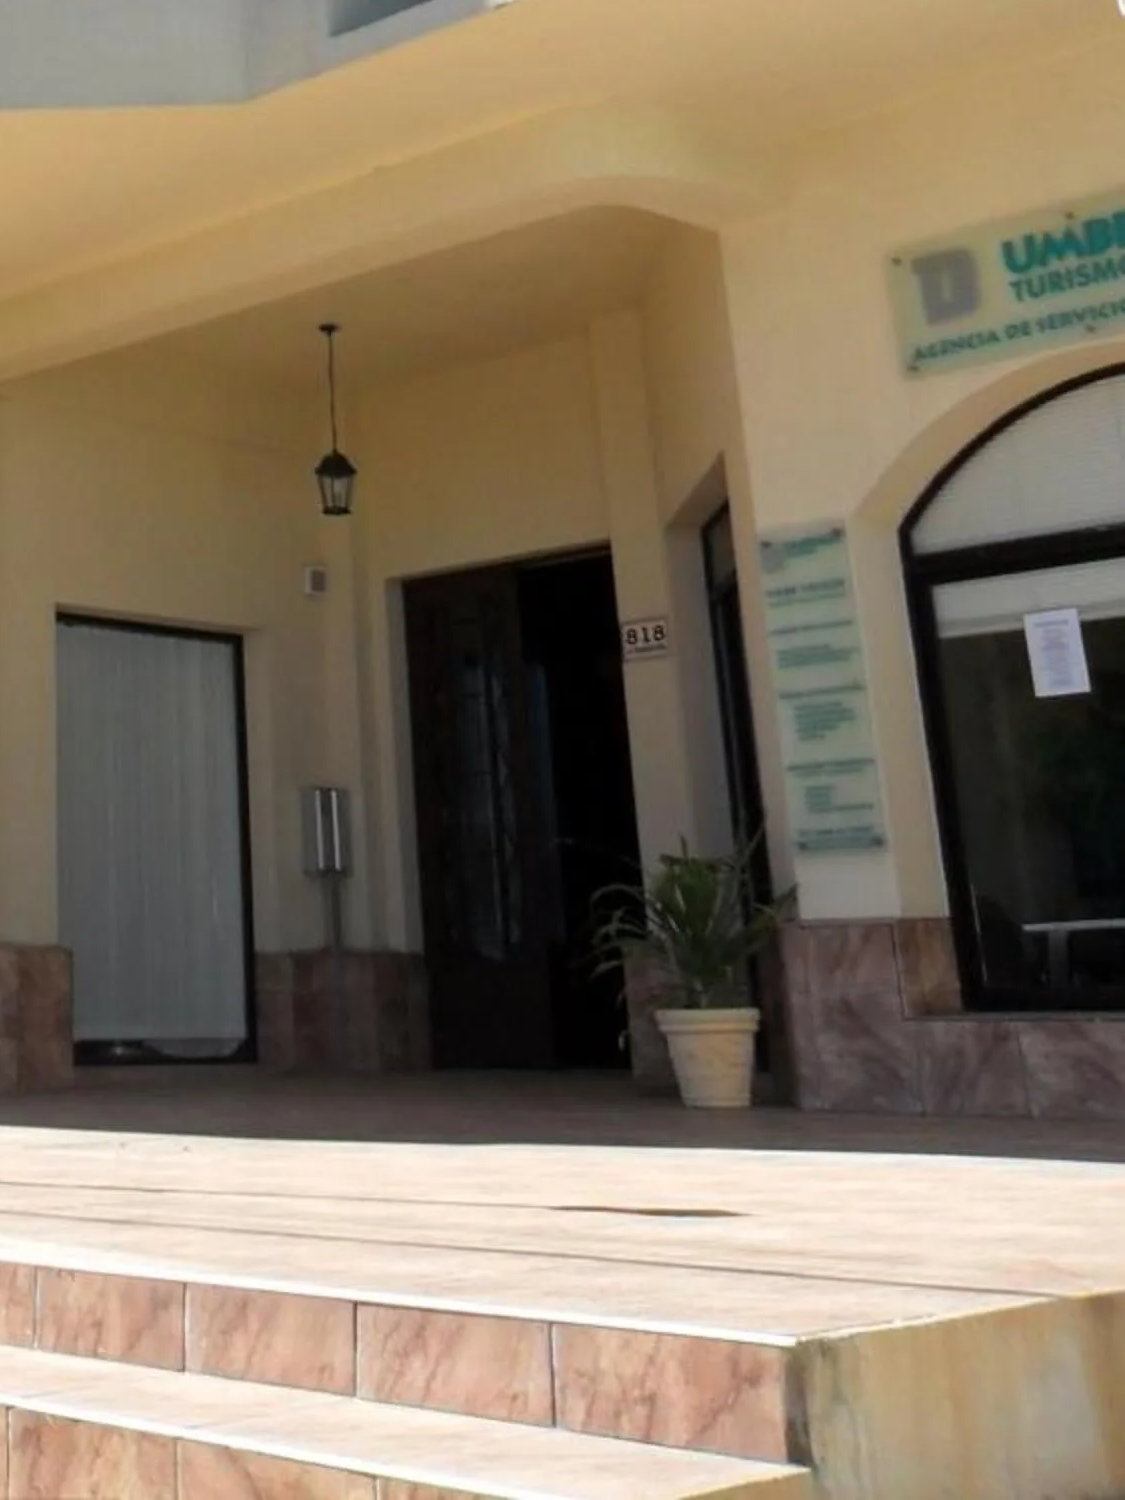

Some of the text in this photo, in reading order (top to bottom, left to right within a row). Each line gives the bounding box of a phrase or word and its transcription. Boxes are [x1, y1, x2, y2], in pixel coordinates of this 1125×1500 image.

[913, 328, 1001, 362] AGENCIA
[1003, 319, 1033, 341] DE
[625, 624, 667, 645] 818
